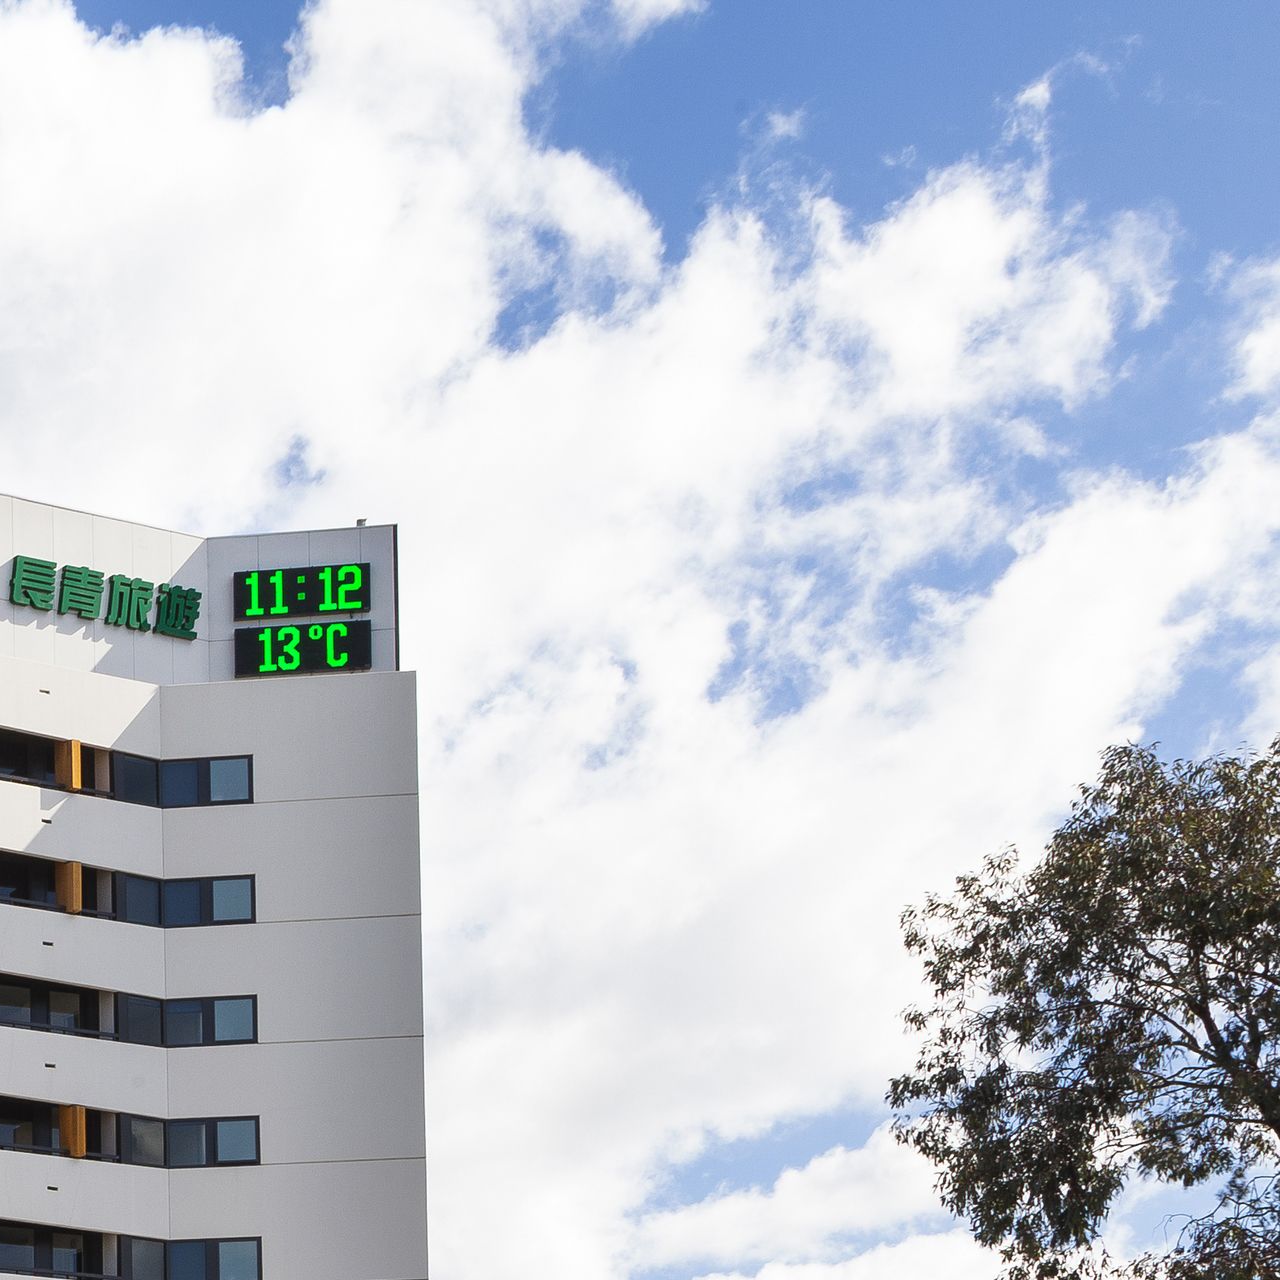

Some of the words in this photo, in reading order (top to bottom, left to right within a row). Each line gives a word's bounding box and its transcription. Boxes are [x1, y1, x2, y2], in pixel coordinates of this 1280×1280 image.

[8, 553, 203, 641] 長青旅遊
[245, 564, 363, 617] 11:12
